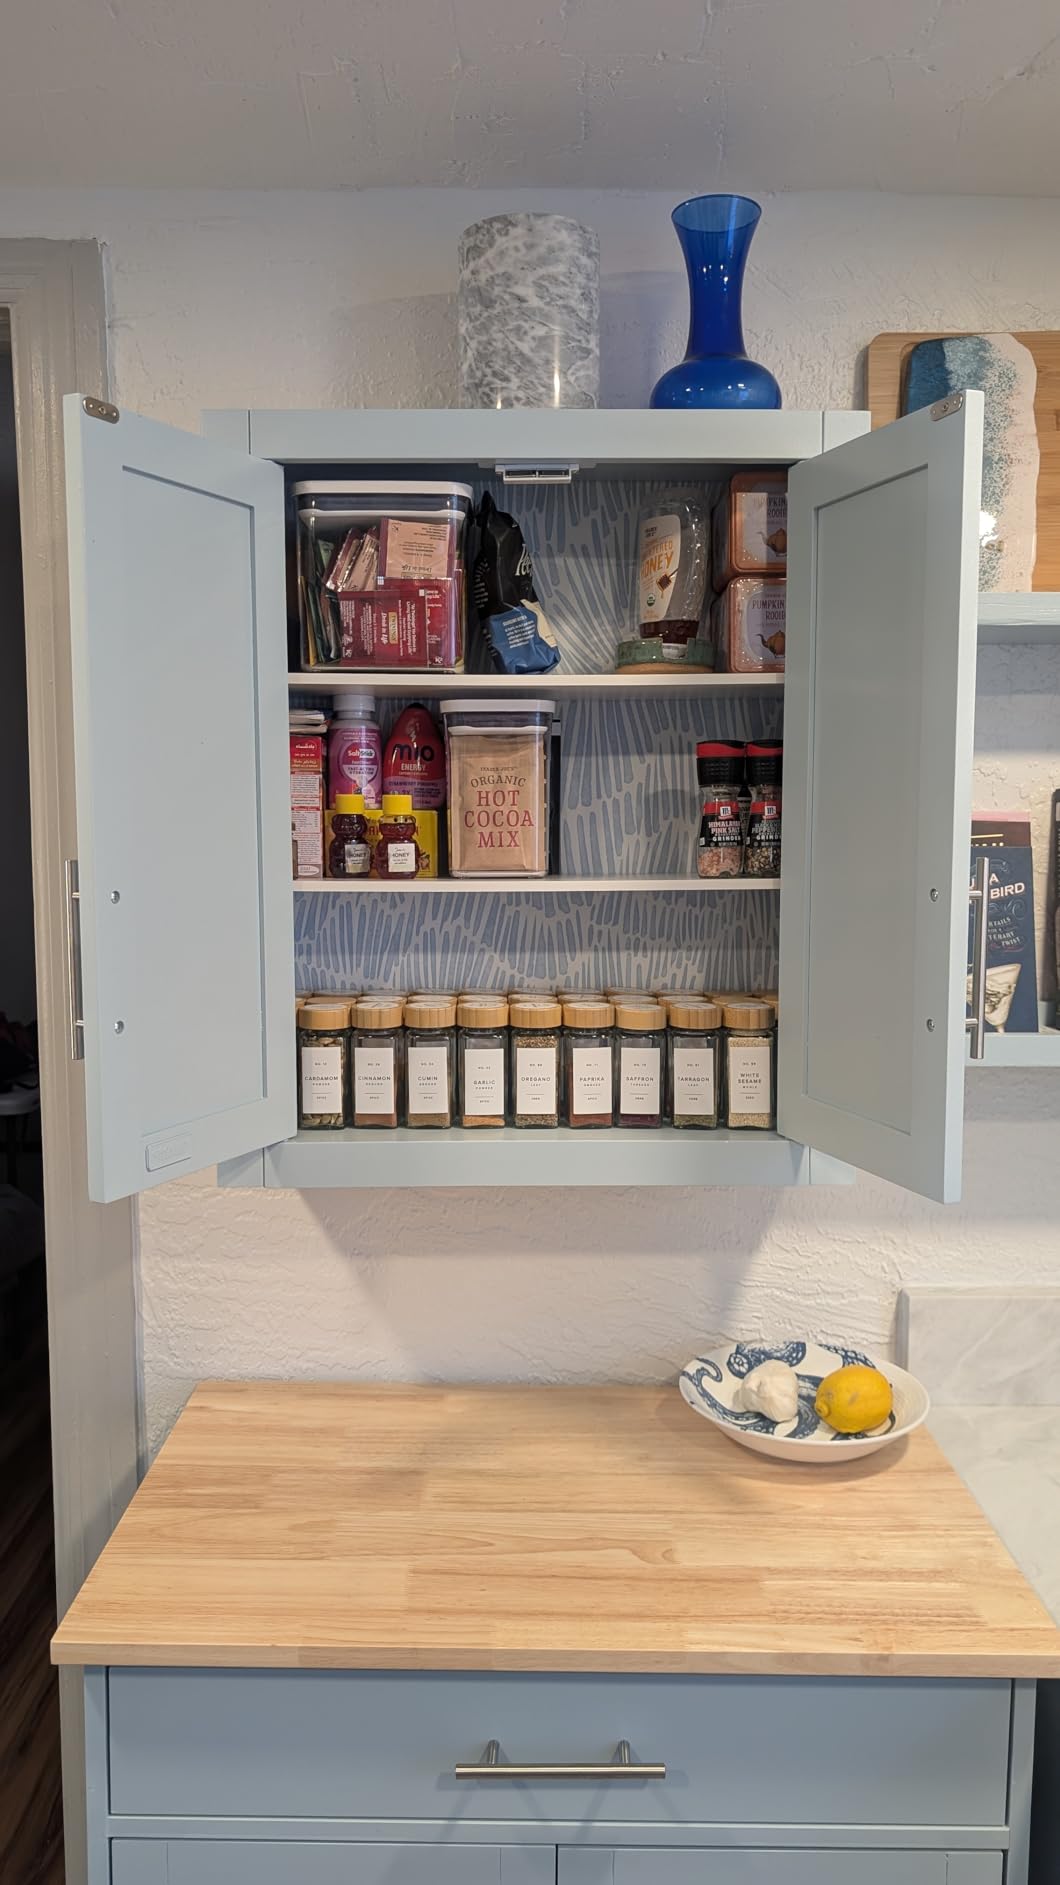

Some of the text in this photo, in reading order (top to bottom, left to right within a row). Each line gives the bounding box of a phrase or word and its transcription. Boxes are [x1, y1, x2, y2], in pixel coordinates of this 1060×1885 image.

[752, 600, 785, 609] PUMPKIN
[380, 634, 388, 645] Life
[392, 741, 434, 761] mio
[401, 763, 426, 771] ENERGY
[470, 775, 527, 788] ORGANIC
[476, 790, 520, 807] HOT
[464, 810, 534, 828] COCOA
[478, 831, 520, 848] MIX
